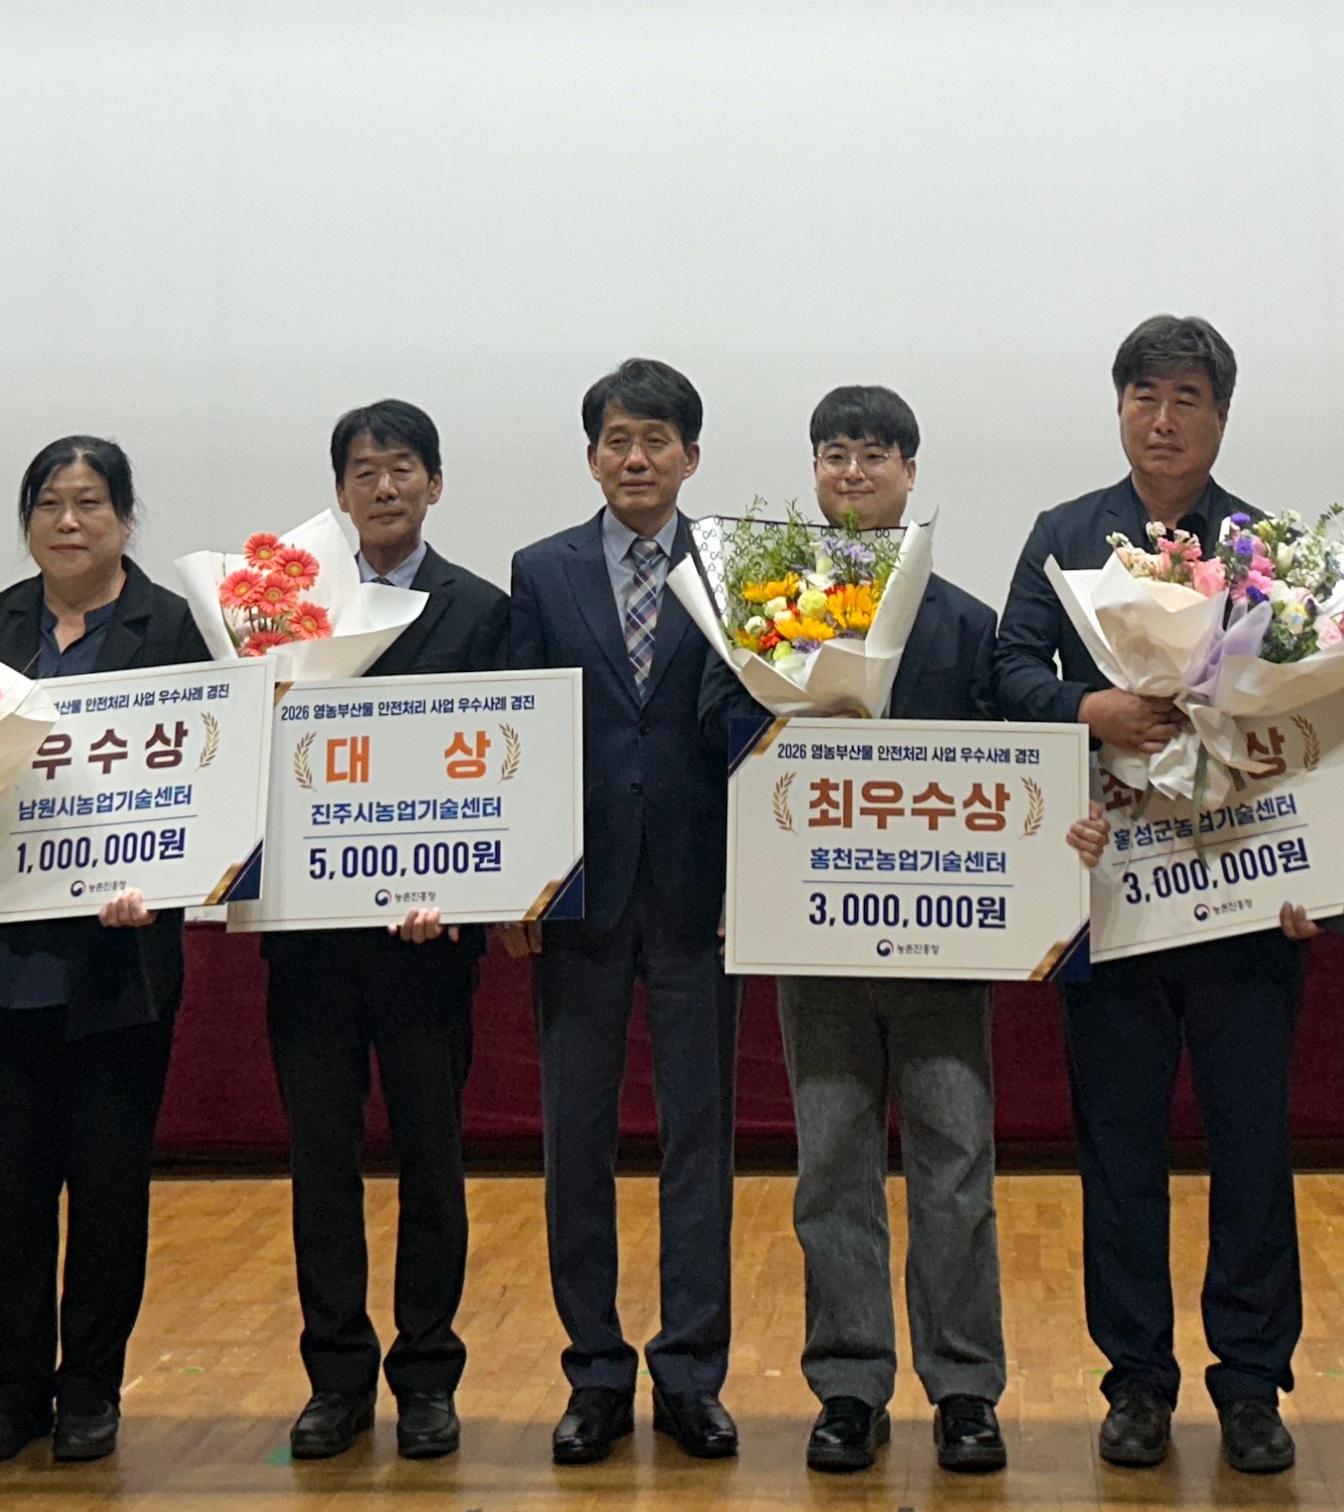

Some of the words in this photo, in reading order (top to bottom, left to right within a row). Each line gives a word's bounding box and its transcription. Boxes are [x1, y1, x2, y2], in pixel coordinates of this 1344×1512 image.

[86, 695, 130, 712] 안전처리
[133, 691, 155, 707] 사업
[158, 687, 203, 705] 우수사례
[281, 705, 309, 720] 2026
[378, 699, 426, 716] 안전처리
[430, 698, 454, 714] 사업
[458, 696, 507, 713] 우수사례
[778, 743, 806, 759] 2026
[878, 746, 928, 762] 안전처리
[931, 747, 957, 762] 사업
[960, 748, 1010, 764] 우수사례
[18, 785, 192, 821] 남원시농업기술센터
[311, 796, 502, 826] 진주시농업기술센터
[808, 778, 1011, 832] 최우수상
[17, 827, 185, 874] 1,000,000원
[309, 840, 502, 880] 5,000,000원
[810, 847, 1006, 874] 홍천군농업기술센터
[1123, 837, 1310, 904] 3,000,000원
[809, 892, 1006, 929] 3,000,000원
